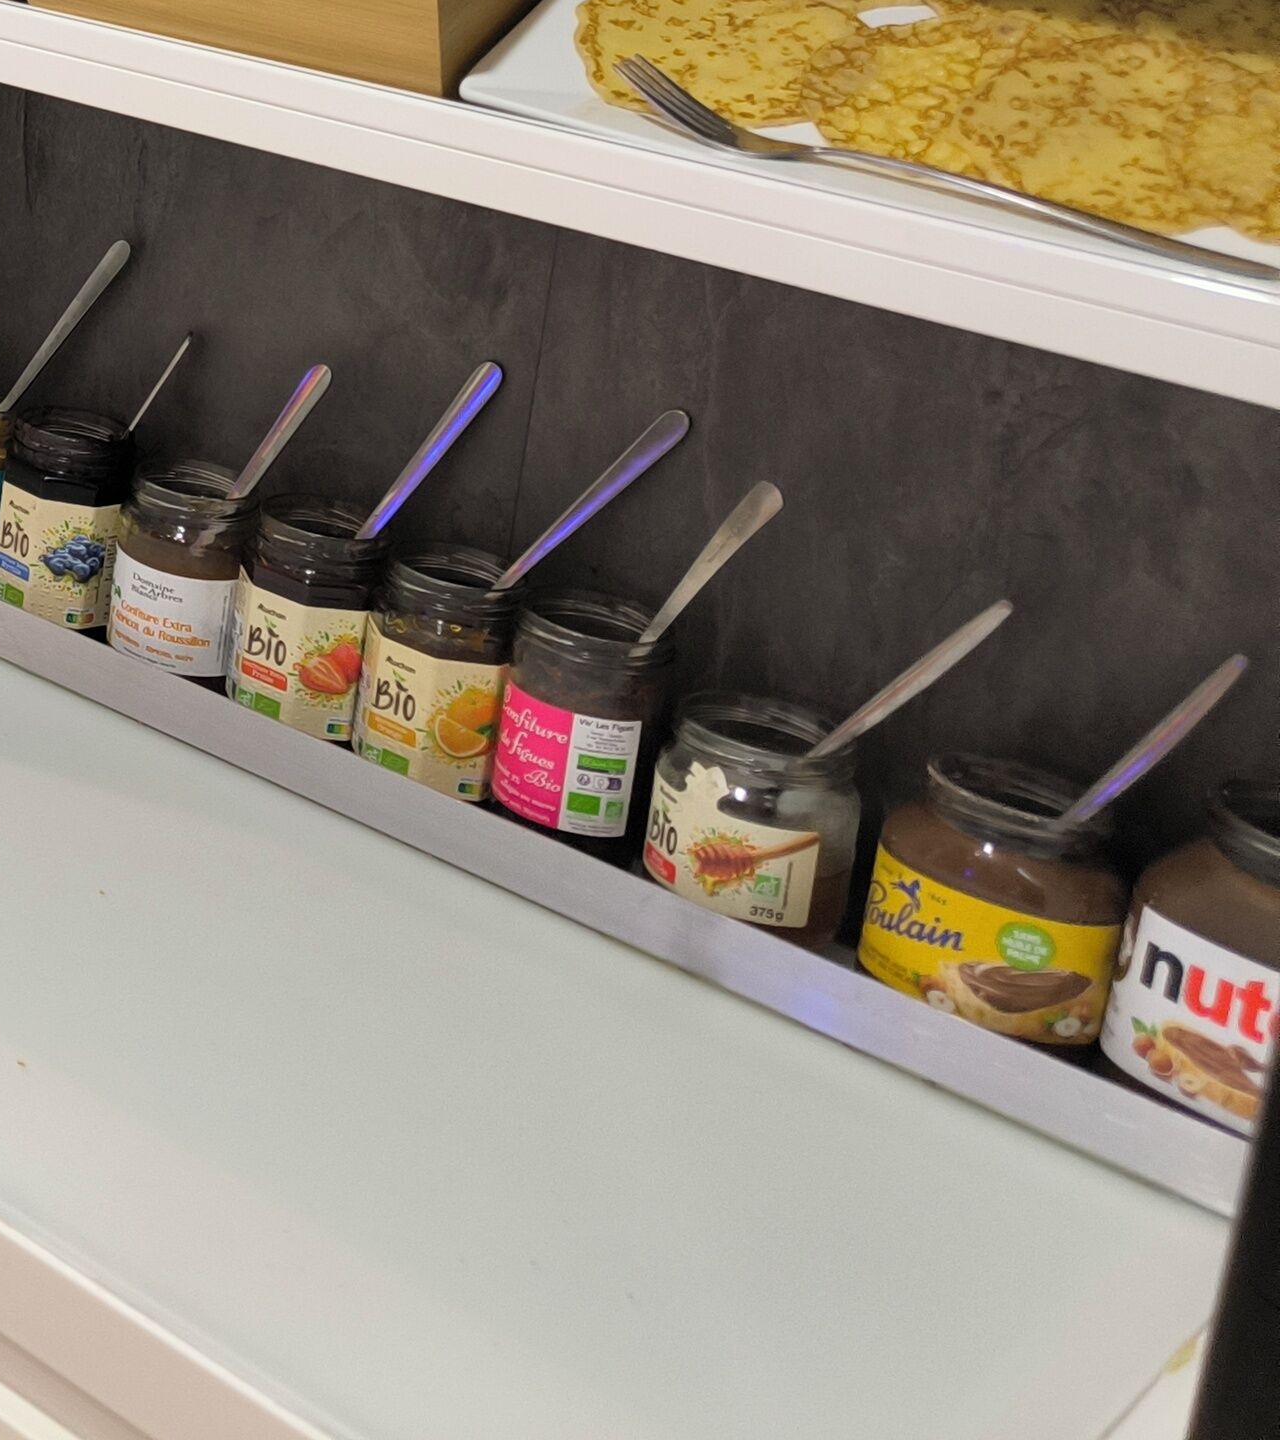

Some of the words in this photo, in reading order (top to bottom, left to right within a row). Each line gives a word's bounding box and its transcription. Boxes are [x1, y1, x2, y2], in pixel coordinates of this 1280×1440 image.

[133, 572, 175, 594] Domaine
[163, 617, 192, 633] Extra
[159, 630, 210, 648] Roussillon
[508, 731, 555, 770] figues
[524, 769, 561, 793] Bio
[1140, 941, 1276, 1044] nut
